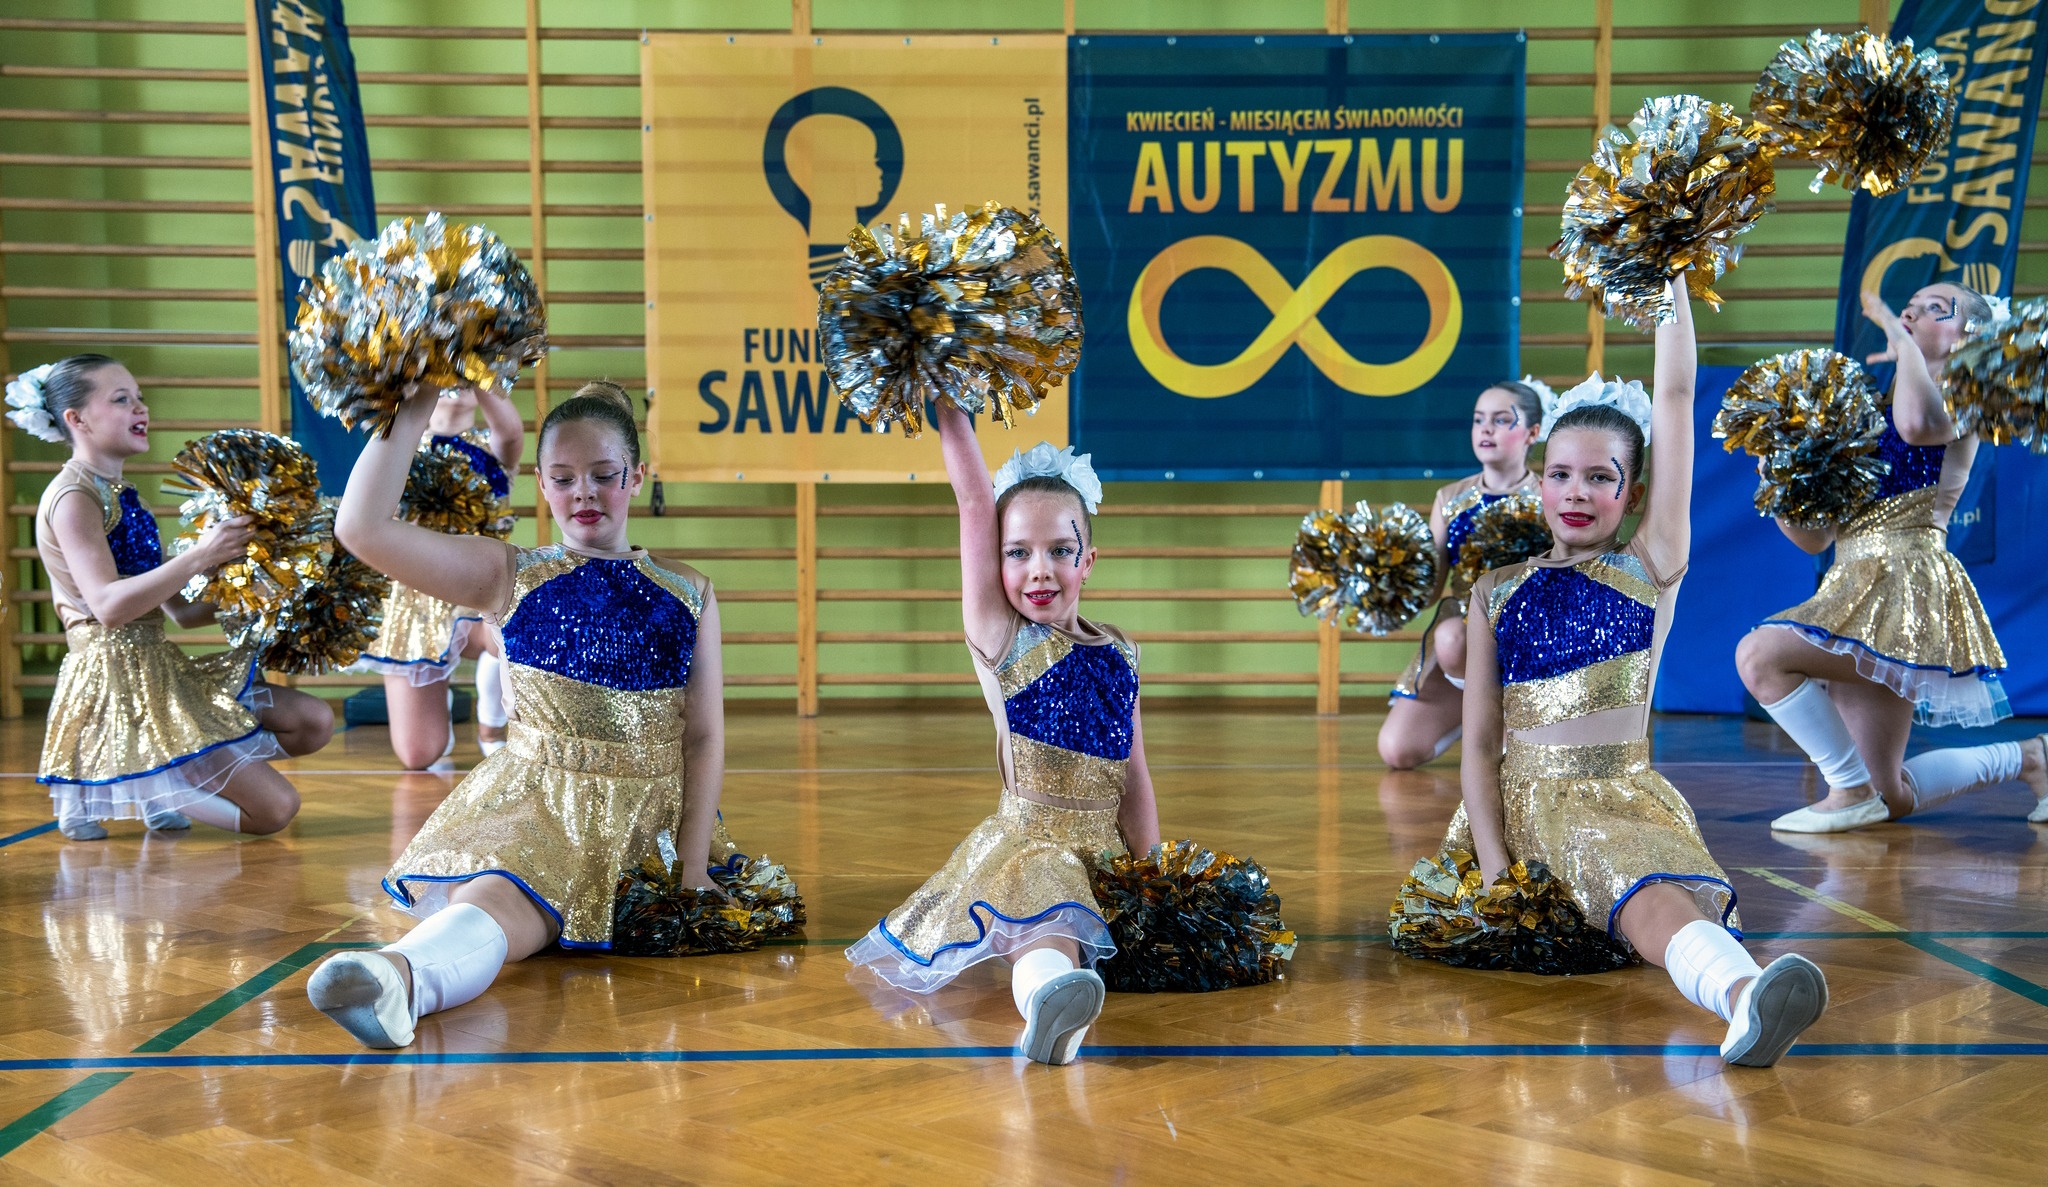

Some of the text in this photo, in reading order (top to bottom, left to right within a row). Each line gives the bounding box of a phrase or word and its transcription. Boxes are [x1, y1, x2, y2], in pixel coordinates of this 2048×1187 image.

[1126, 107, 1214, 131] KWIECIEŃ
[1230, 109, 1330, 135] MIESIĄCEM
[1334, 103, 1463, 129] ŚWIADOMOŚCI
[1128, 137, 1464, 213] AUTYZMU
